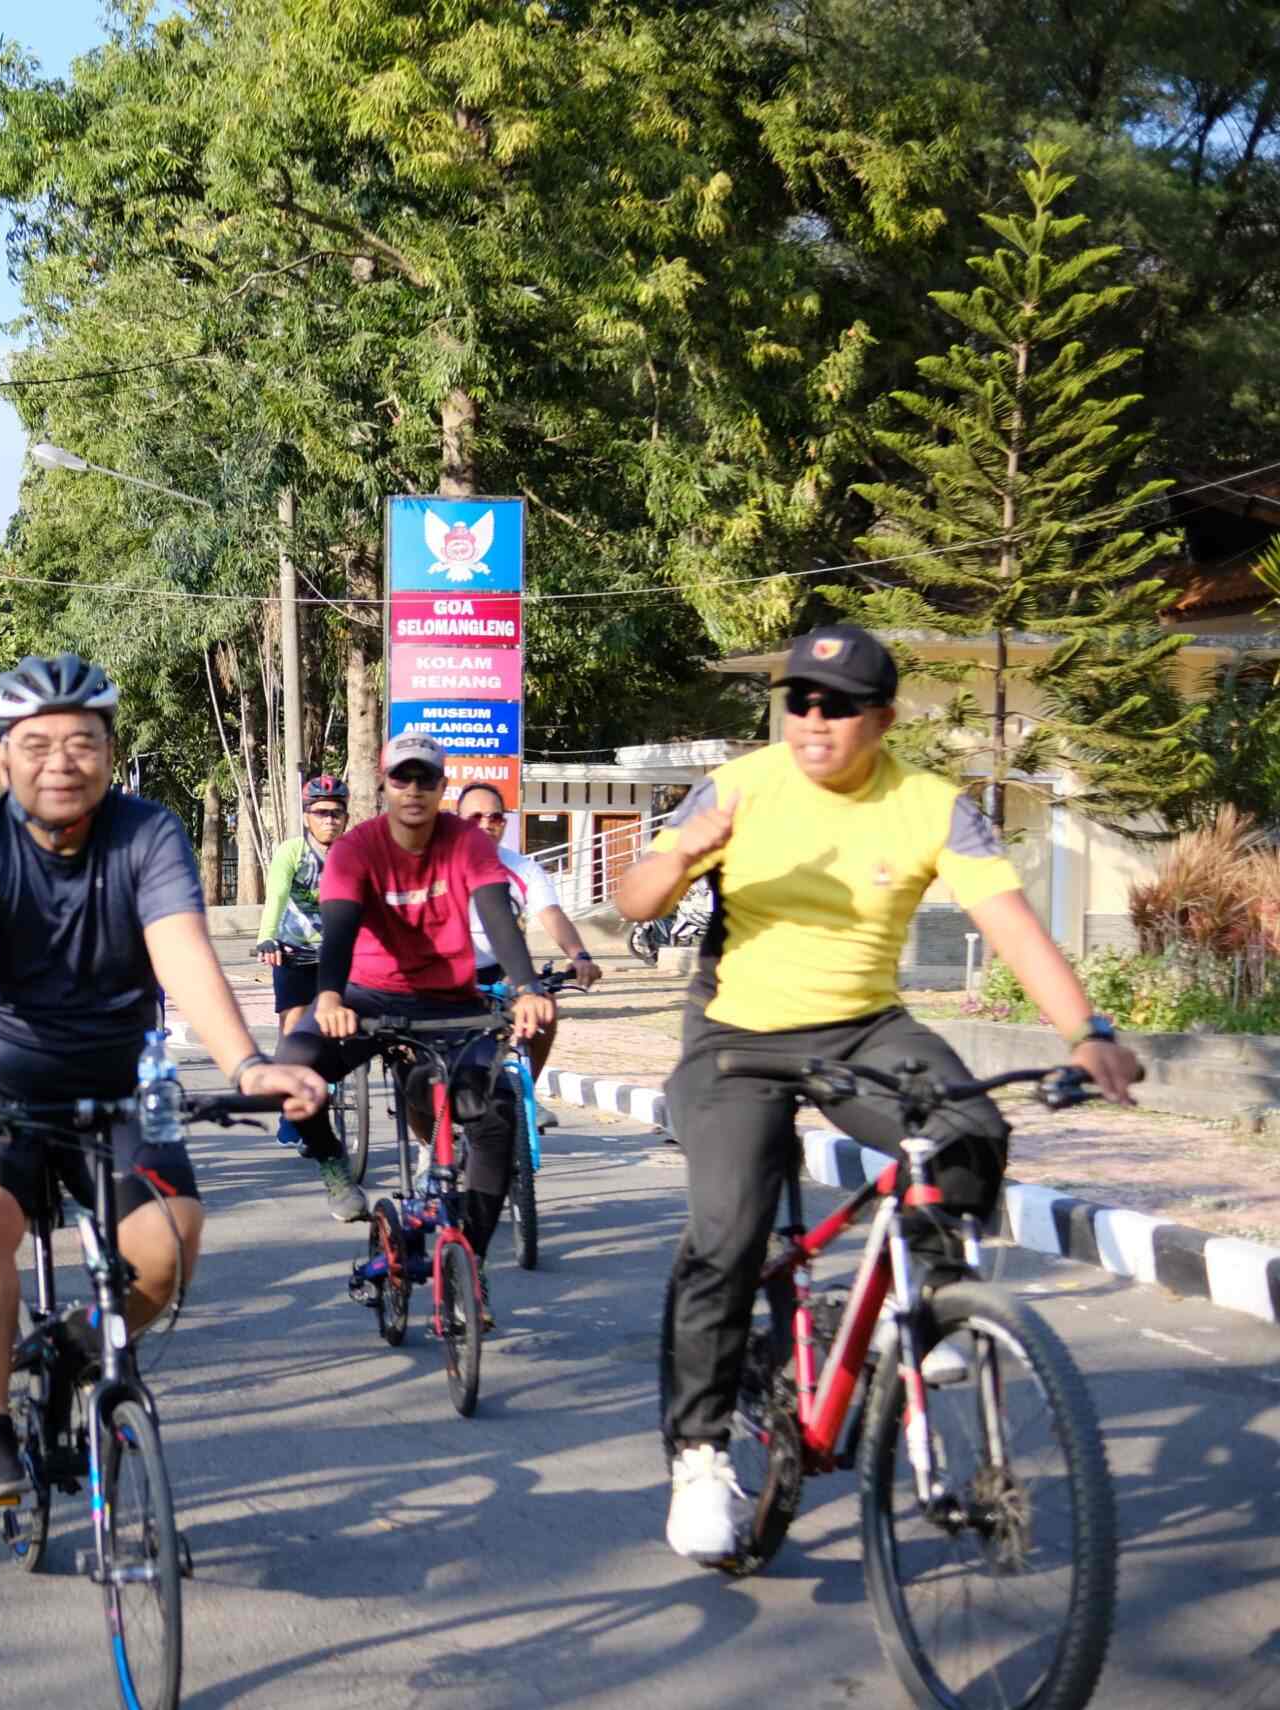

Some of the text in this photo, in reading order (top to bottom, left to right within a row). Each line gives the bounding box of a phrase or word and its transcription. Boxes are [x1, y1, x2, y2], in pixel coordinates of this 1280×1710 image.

[434, 600, 474, 615] GOA
[398, 619, 515, 636] SELOMANGLENG
[416, 657, 491, 669] KOLAM
[411, 676, 501, 688] RENANG
[423, 708, 491, 718] MUSEUM
[404, 722, 508, 733] AIRLANGGA &
[463, 766, 508, 779] PANJI
